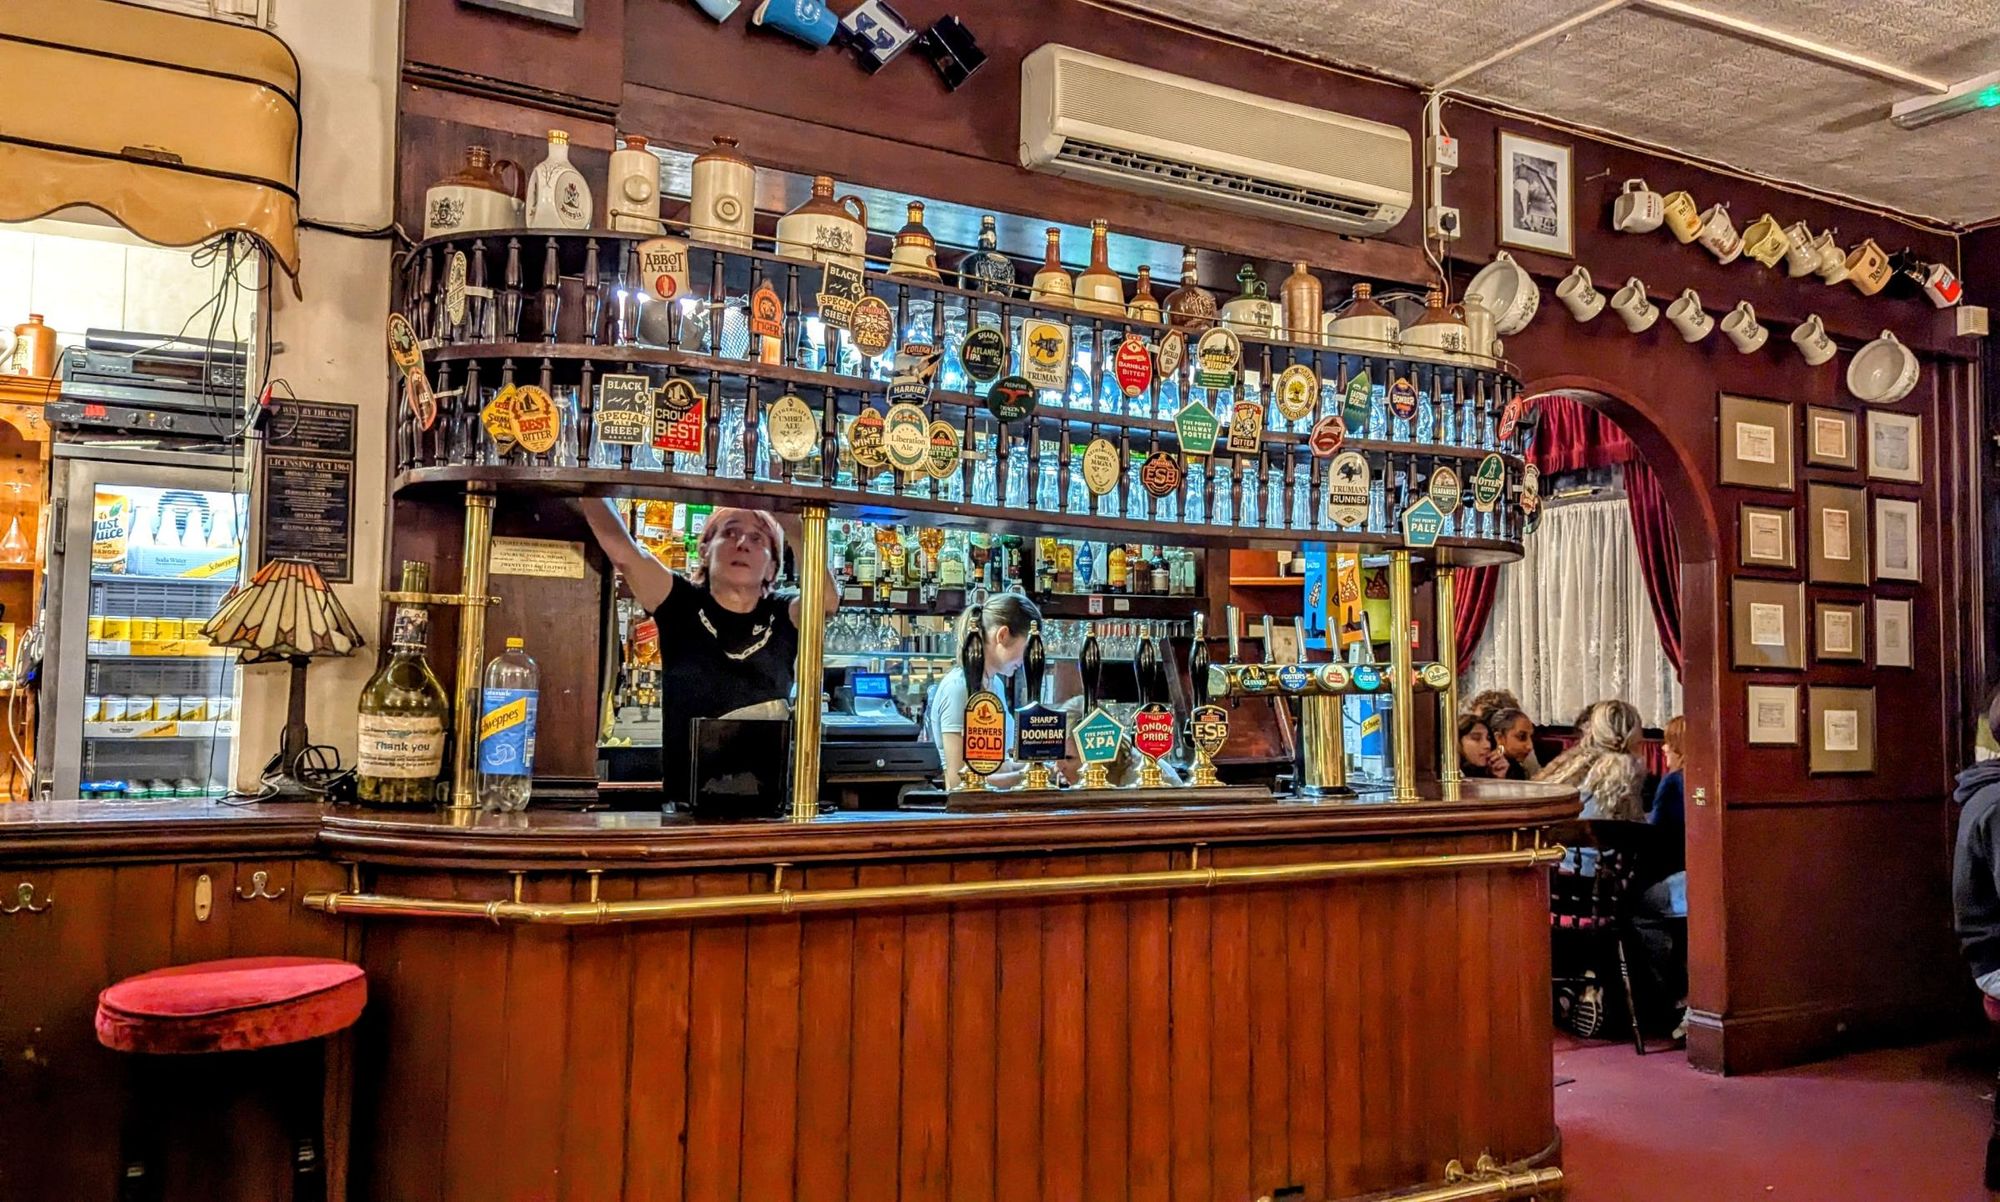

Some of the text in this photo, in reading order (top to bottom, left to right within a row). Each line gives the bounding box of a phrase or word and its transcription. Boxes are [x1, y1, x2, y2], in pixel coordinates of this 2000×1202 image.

[643, 252, 684, 272] ABBOT
[829, 266, 858, 282] BLACK
[820, 296, 856, 311] SPECIA
[755, 323, 780, 337] TIGER
[859, 329, 884, 341] JACK
[857, 337, 887, 348] FROST
[1119, 361, 1149, 371] BARNSLEY
[1122, 369, 1146, 377] BITTER
[607, 381, 642, 391] BLACK
[894, 385, 927, 395] HARRIER
[598, 410, 649, 426] SPECIAL
[655, 408, 700, 424] CROUCH
[518, 416, 552, 432] BEST
[784, 422, 800, 430] ALE
[1183, 425, 1212, 433] RAILWAY
[522, 430, 553, 441] BITTER
[604, 426, 640, 436] SHEEP
[655, 421, 700, 440] BEST
[862, 426, 878, 435] OLD
[1183, 431, 1212, 439] PORTER
[654, 437, 699, 447] BITTER
[891, 433, 926, 445] Liberation
[1233, 437, 1254, 447] BITTER
[901, 443, 914, 452] Ale
[269, 458, 314, 469] LICENSING
[315, 461, 332, 470] ACT
[1146, 467, 1176, 484] ESB
[1332, 495, 1366, 504] RUNNER
[1411, 523, 1437, 533] PALE
[1030, 716, 1058, 724] SHARP'S
[968, 727, 1002, 736] BREWERS
[1138, 723, 1174, 734] LONDON
[1195, 724, 1227, 740] ESB
[1021, 729, 1064, 740] DOOM BAR
[1142, 733, 1169, 741] PRIDE
[375, 741, 431, 753] Thank you
[967, 737, 1002, 750] GOLD
[1084, 737, 1115, 749] XPA
